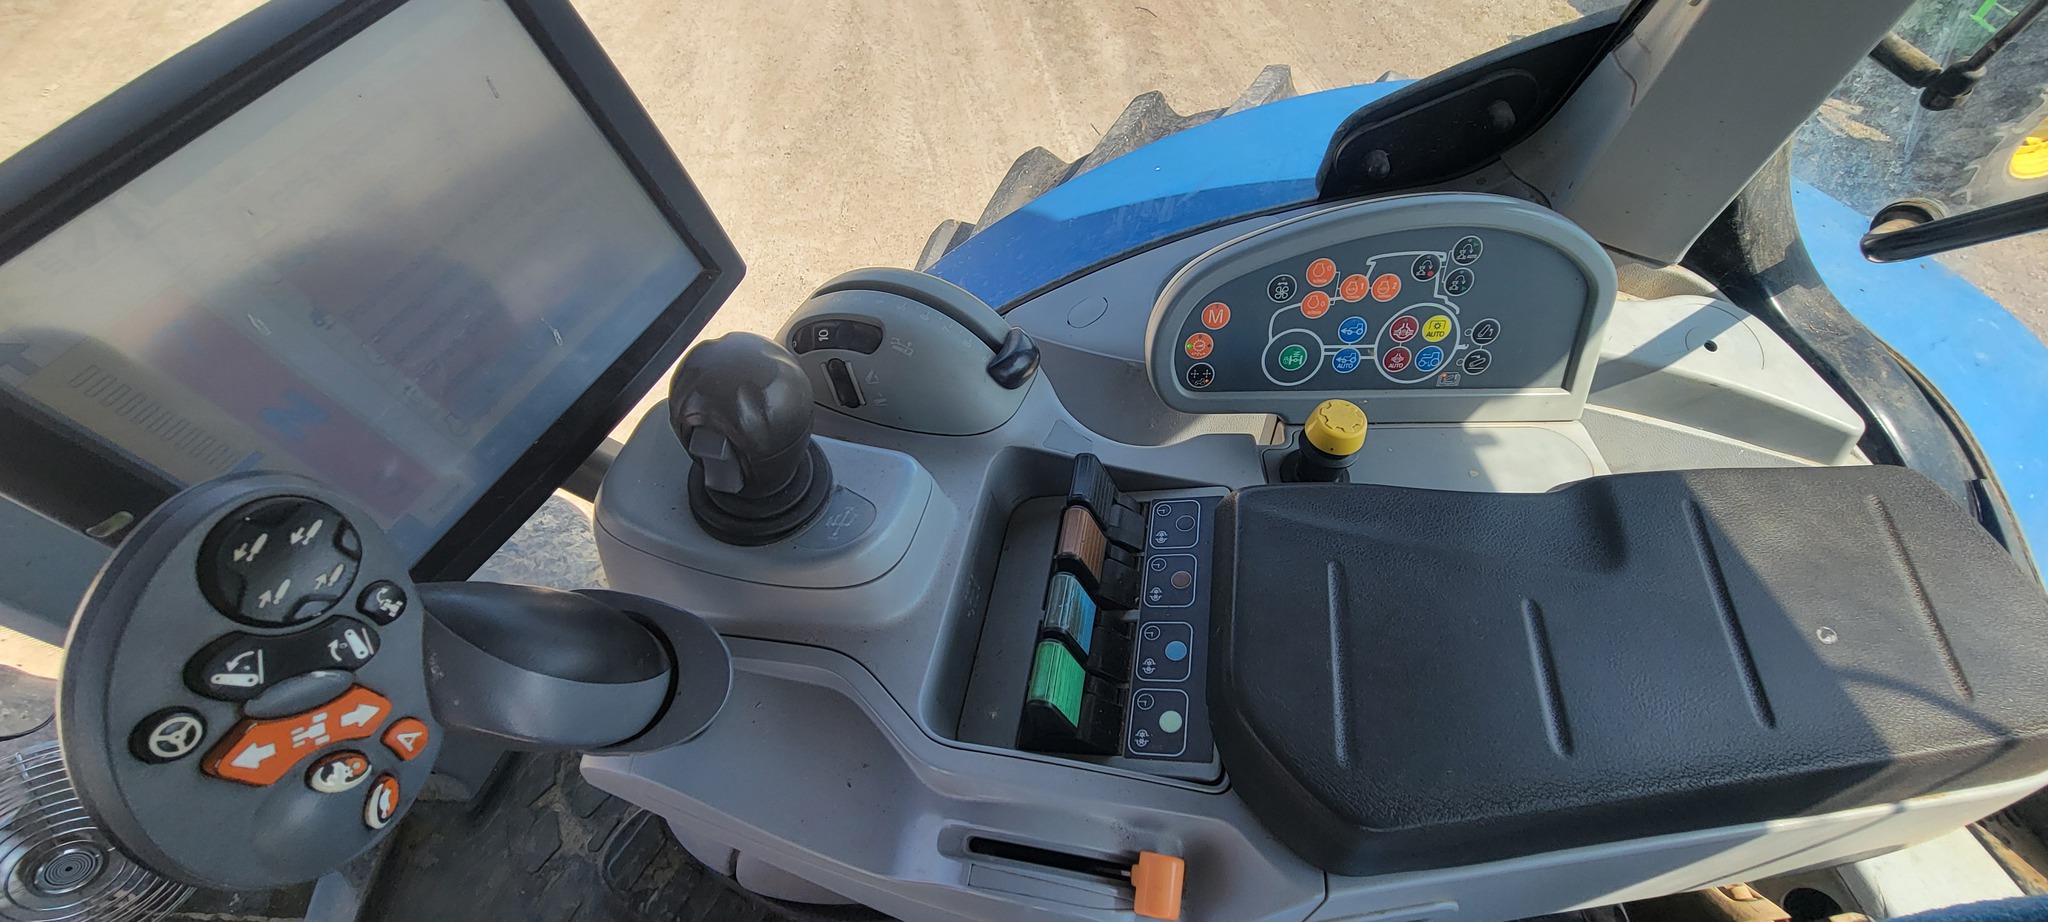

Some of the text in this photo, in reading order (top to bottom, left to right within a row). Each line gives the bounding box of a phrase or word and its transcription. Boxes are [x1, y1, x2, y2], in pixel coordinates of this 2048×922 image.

[1360, 282, 1365, 290] 1
[1392, 282, 1398, 290] 2
[1208, 309, 1224, 324] M
[818, 329, 829, 342] 10
